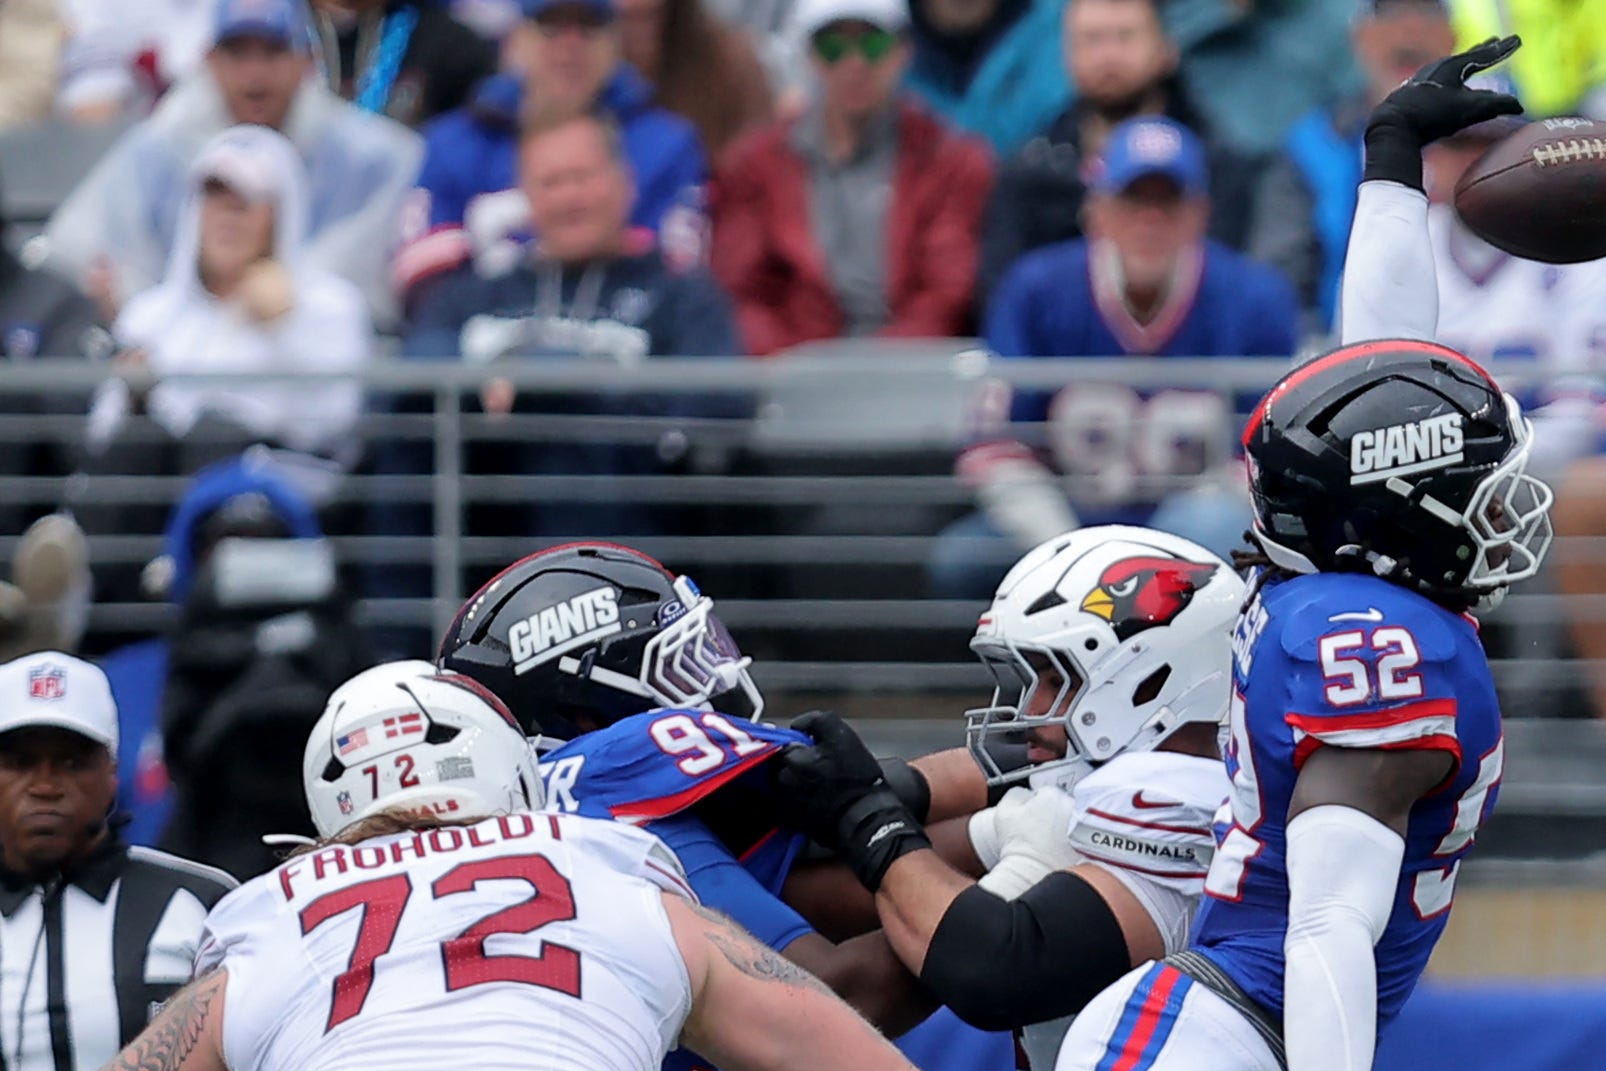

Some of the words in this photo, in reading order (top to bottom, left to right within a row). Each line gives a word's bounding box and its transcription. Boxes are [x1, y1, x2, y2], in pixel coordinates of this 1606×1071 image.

[1350, 412, 1464, 474] GIANTS
[508, 586, 619, 664] GIANTS
[1318, 625, 1425, 707] 52
[362, 754, 420, 800] 72
[648, 712, 772, 777] 91
[279, 812, 567, 901] FROHOLDT
[1090, 832, 1196, 860] CARDINALS
[298, 853, 583, 1036] 72
